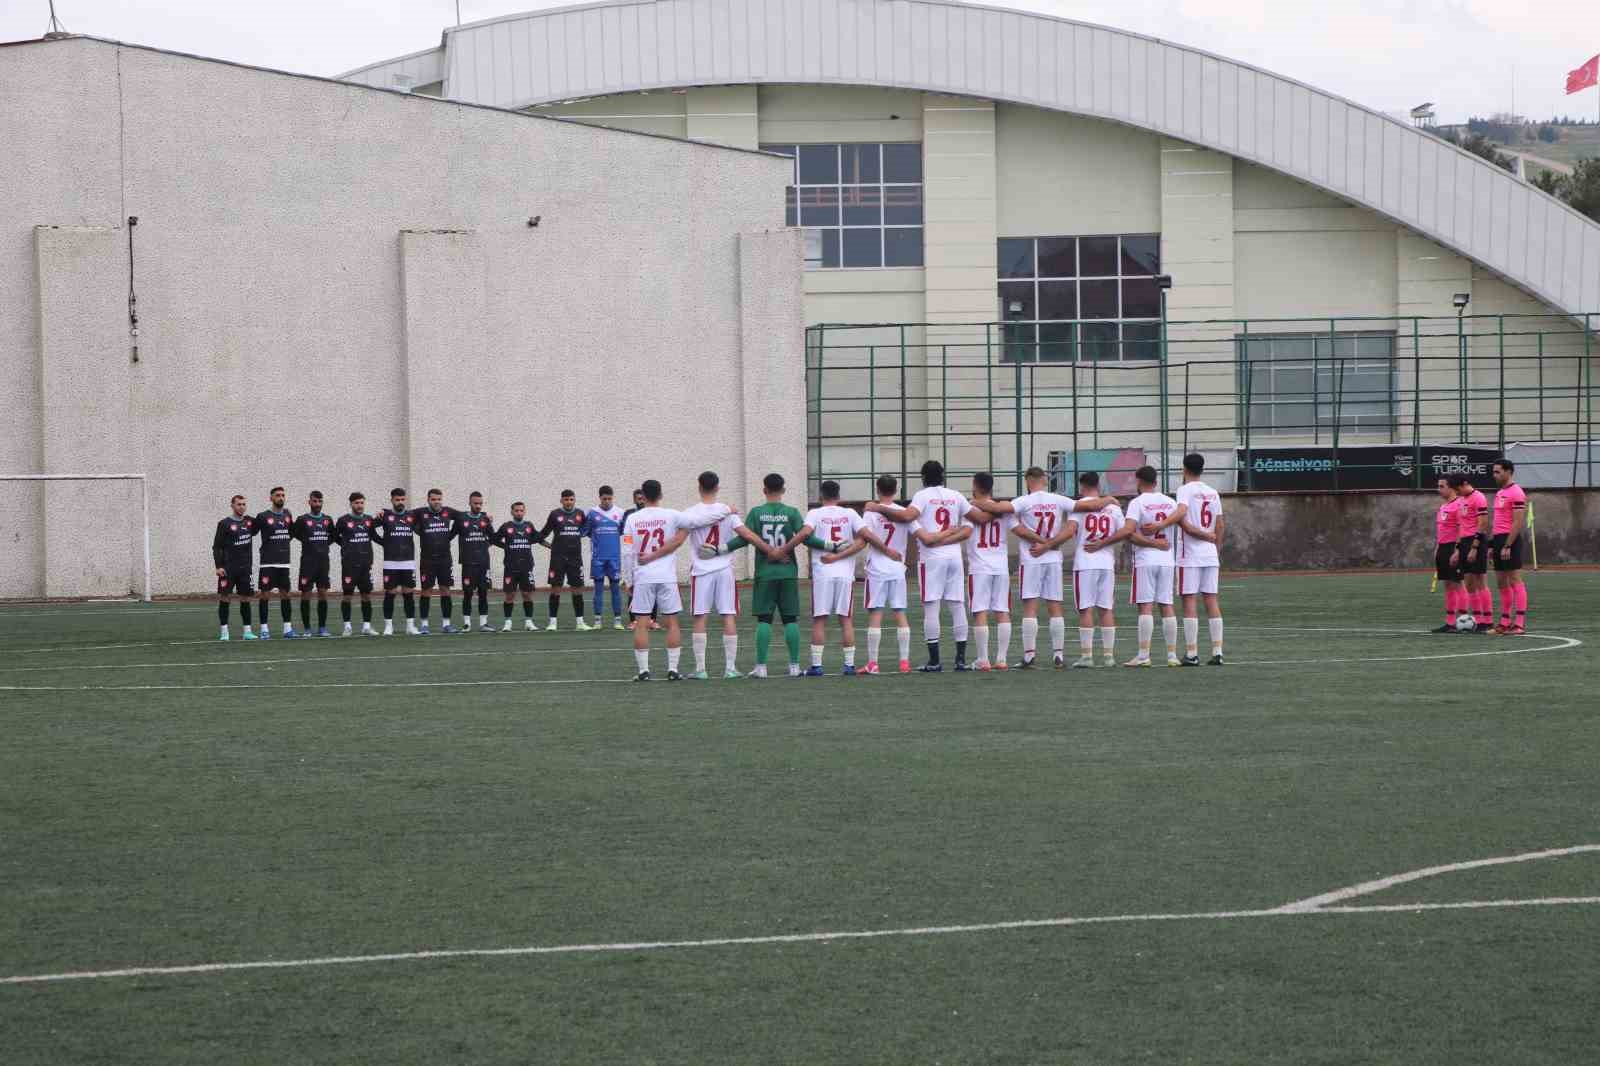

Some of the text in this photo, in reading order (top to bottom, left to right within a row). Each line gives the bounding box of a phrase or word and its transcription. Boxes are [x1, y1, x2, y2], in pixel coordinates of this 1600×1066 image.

[935, 506, 950, 532] 9
[1034, 511, 1056, 538] 77
[1200, 501, 1212, 528] 6
[637, 528, 665, 553] 73
[705, 523, 720, 549] 4
[762, 523, 786, 549] 56
[883, 523, 896, 546] 7
[977, 519, 1001, 549] 10
[1085, 514, 1110, 542] 99
